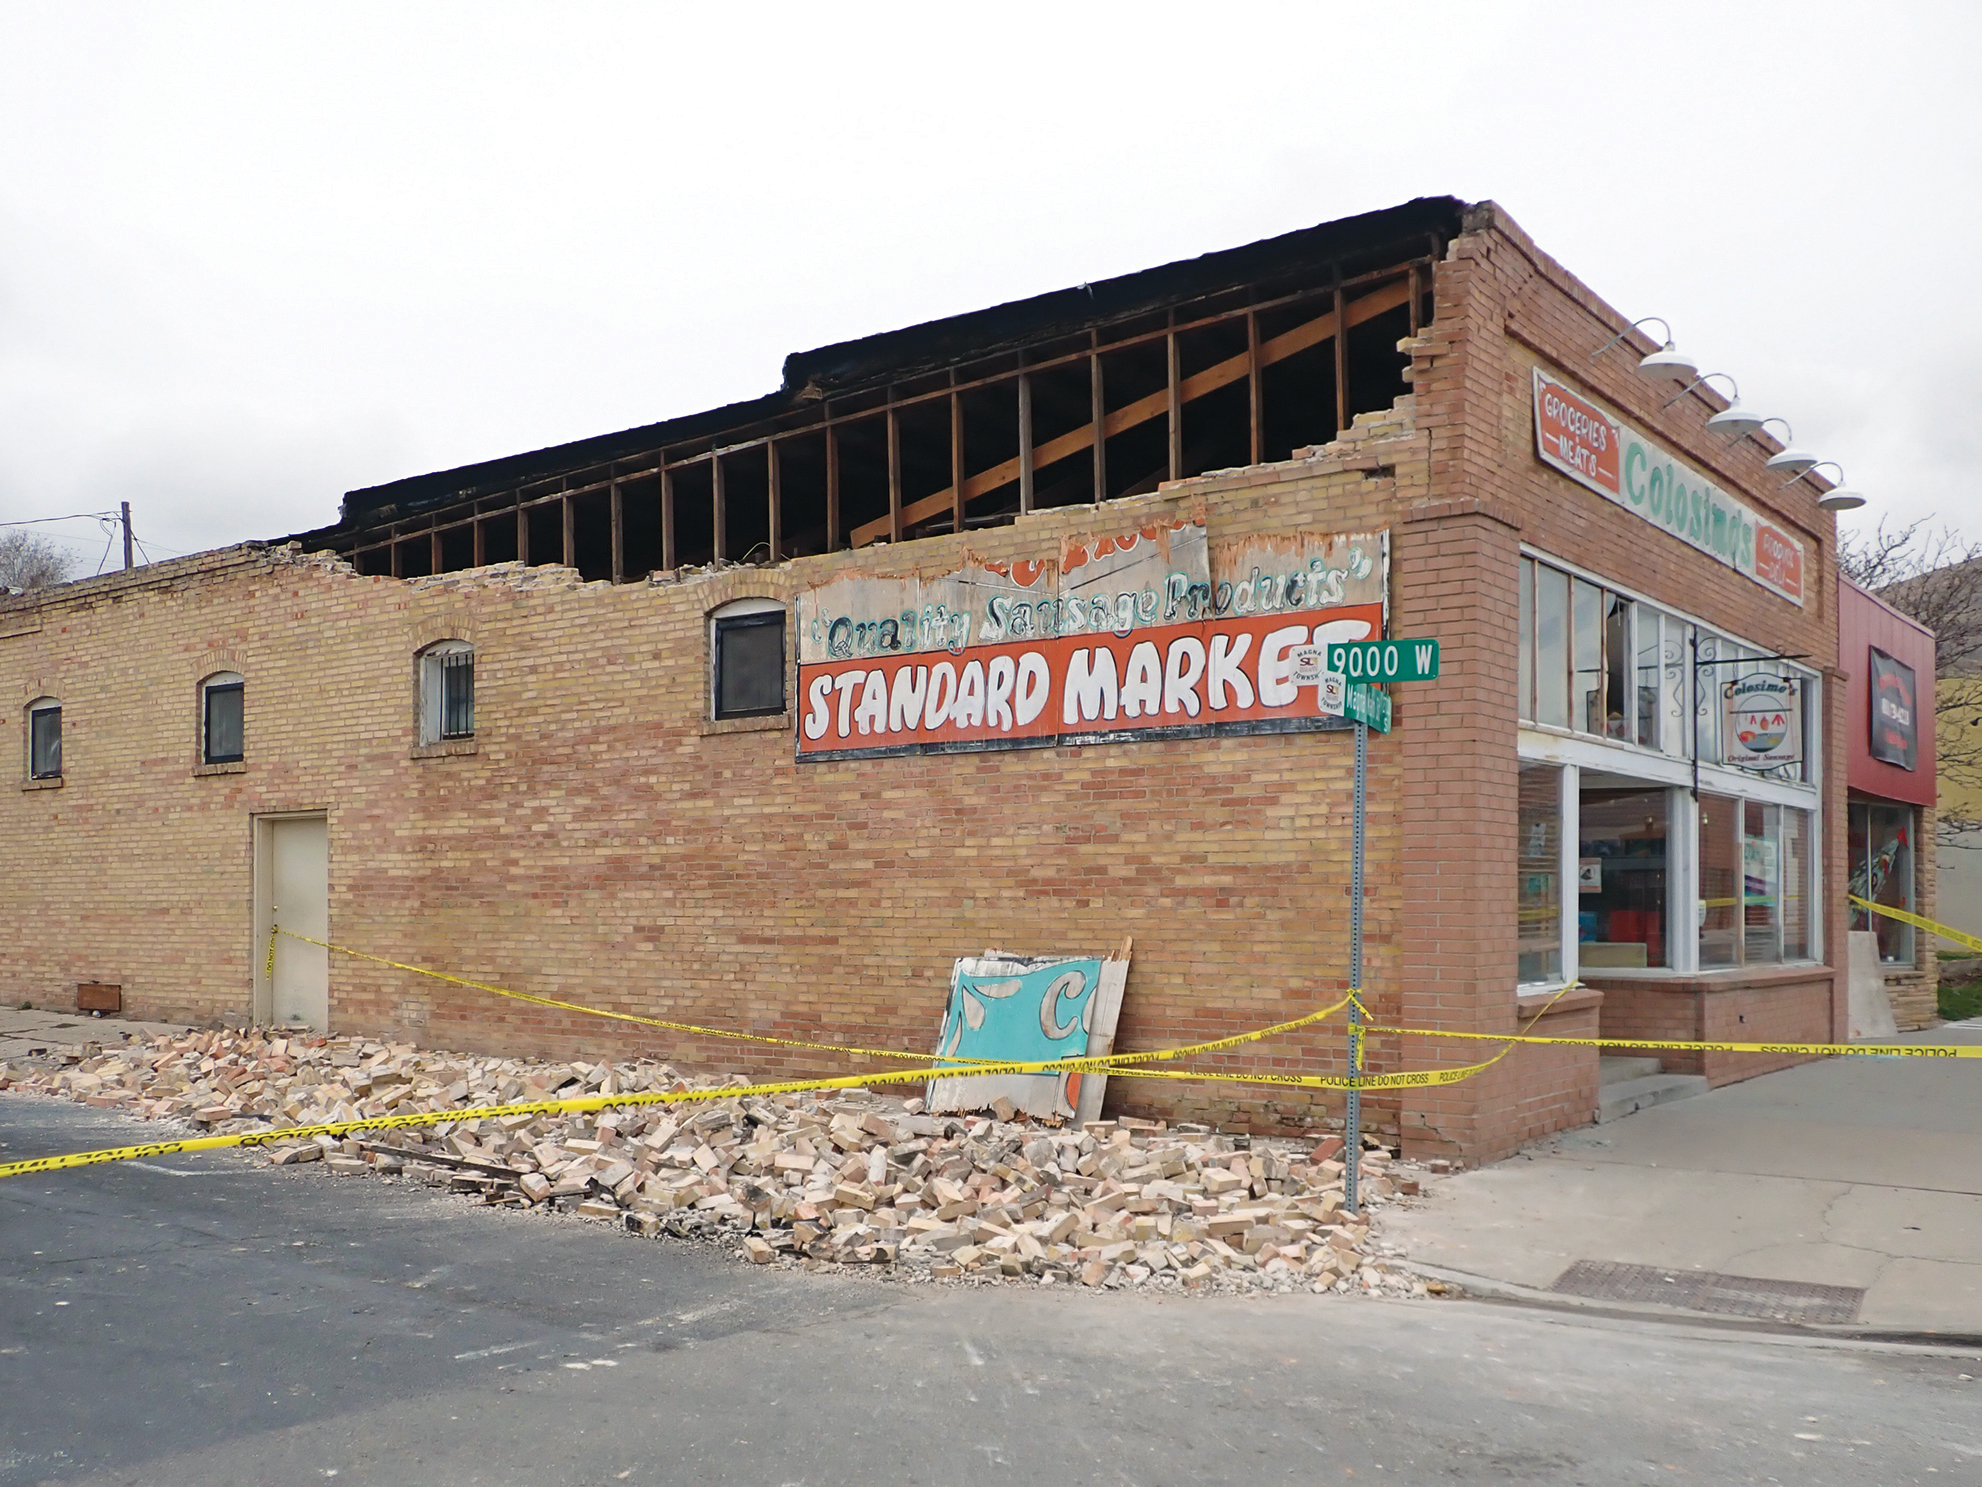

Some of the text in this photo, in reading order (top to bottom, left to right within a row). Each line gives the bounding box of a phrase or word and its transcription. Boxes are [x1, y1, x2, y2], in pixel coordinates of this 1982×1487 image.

[1544, 393, 1607, 452] GROCERIES
[1559, 434, 1597, 478] MEATS
[978, 588, 1160, 638] Sausage
[1296, 648, 1322, 658] MAGNA
[1333, 644, 1433, 678] 9000 W
[1293, 669, 1322, 681] TOWNSH
[1324, 676, 1342, 688] MAGNA
[804, 651, 1051, 740] STANDARD
[1321, 697, 1342, 711] TOWNSHIP
[1870, 1047, 1901, 1057] LINE
[1320, 1073, 1429, 1087] POLICE LINE DO NOT CROSS
